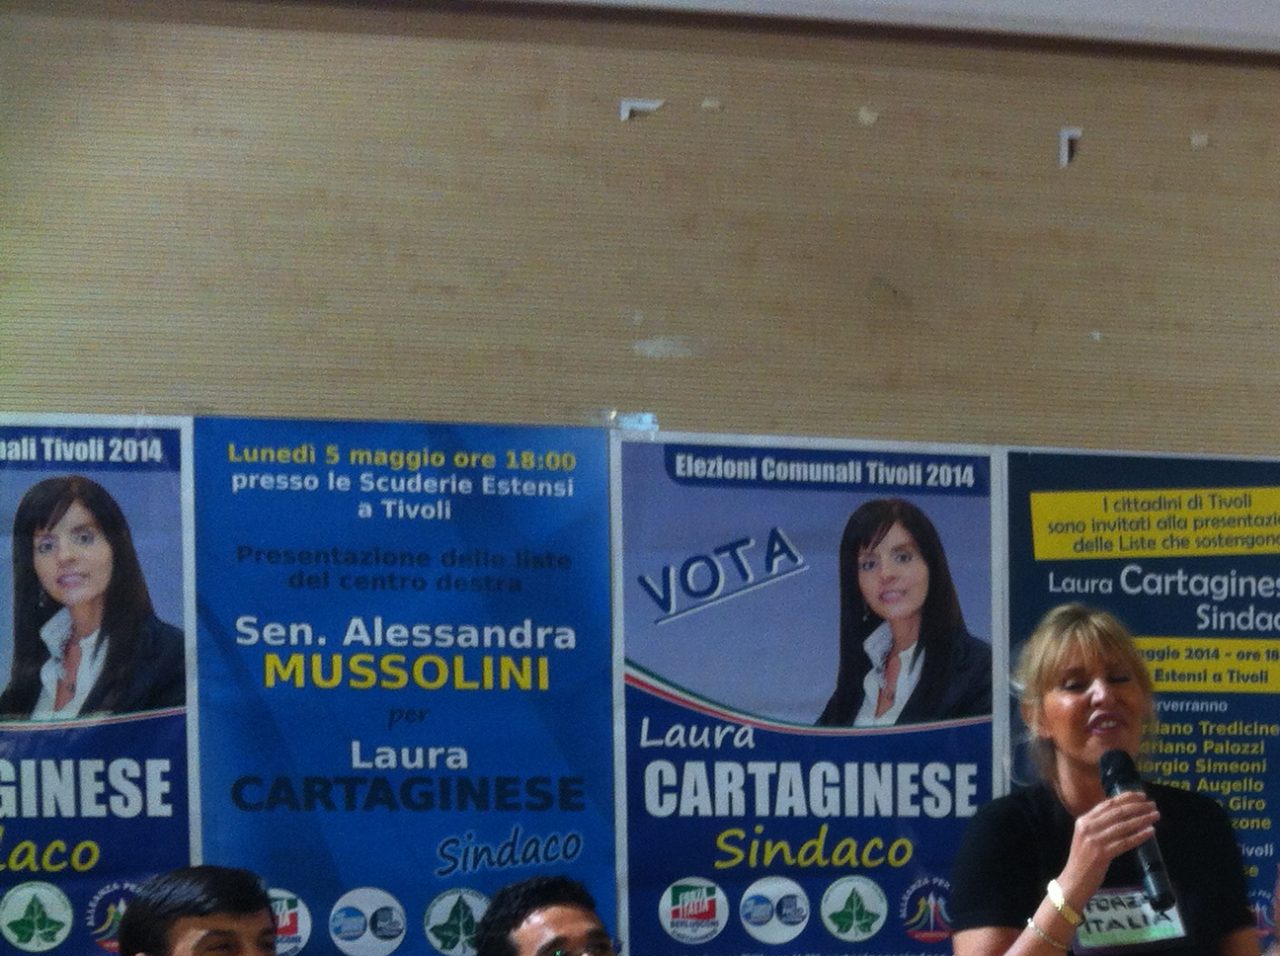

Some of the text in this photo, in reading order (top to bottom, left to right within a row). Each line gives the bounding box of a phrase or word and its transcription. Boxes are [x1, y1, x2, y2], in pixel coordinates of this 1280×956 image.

[41, 437, 104, 462] Tivoli
[108, 438, 163, 463] 2014
[325, 444, 340, 465] 5
[349, 447, 446, 472] maggio
[453, 452, 496, 469] ore
[506, 449, 577, 471] 18:00
[675, 454, 975, 489] Elezioni Comunali Tivoli 2014
[232, 470, 575, 497] presso le Scuderie Estensi
[357, 499, 452, 520] a Tivoli
[1113, 496, 1182, 512] cittadini
[1187, 495, 1203, 511] di
[1207, 493, 1252, 509] Tivoli
[1047, 520, 1086, 534] sono
[1091, 517, 1151, 533] invitati
[1156, 515, 1188, 531] alla
[1072, 537, 1113, 553] delle
[1119, 535, 1156, 551] Liste
[1161, 534, 1190, 549] che
[236, 545, 431, 568] Presentazione
[637, 526, 807, 614] VOTA
[339, 573, 427, 592] centro
[1048, 571, 1113, 594] Laura
[235, 615, 577, 651] Sen. Alessandra
[1184, 647, 1220, 661] 2014
[1236, 650, 1261, 661] ore
[263, 653, 550, 691] MUSSOLINI
[1154, 668, 1268, 684] Estensi a Tivoli
[387, 705, 430, 730] per
[1154, 700, 1229, 713] rverranno
[639, 716, 755, 749] Laura
[1199, 720, 1280, 736] Tredicine
[350, 740, 469, 771] Laura
[1203, 740, 1265, 755] Palozzi
[1196, 757, 1267, 773] Simeoni
[230, 776, 586, 813] CARTAGINESE
[643, 759, 978, 818] CARTAGINESE
[1197, 777, 1264, 795] Augello
[1229, 796, 1266, 812] Giro
[1231, 817, 1272, 830] zone
[0, 825, 100, 872] aco
[433, 826, 581, 877] Sindaco
[714, 824, 913, 870] Sindaco
[1237, 843, 1274, 857] ivoli
